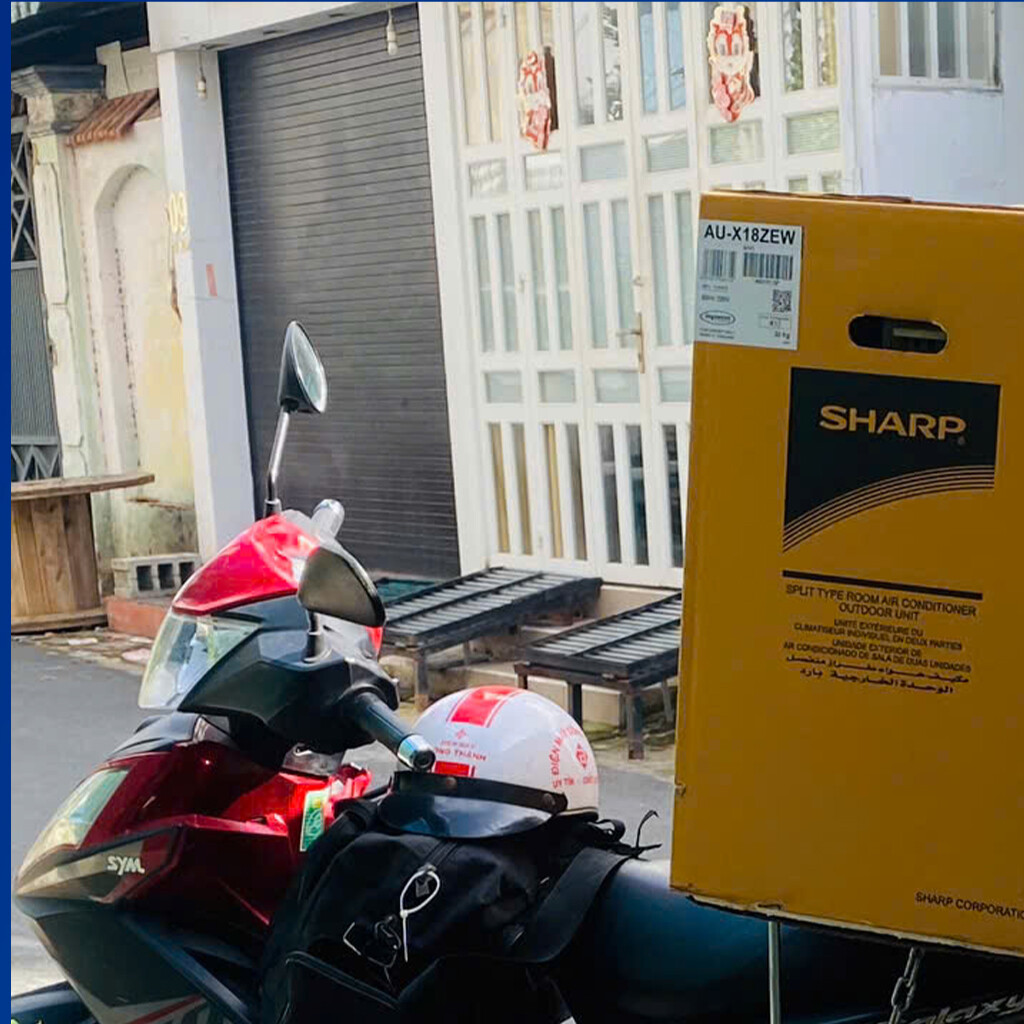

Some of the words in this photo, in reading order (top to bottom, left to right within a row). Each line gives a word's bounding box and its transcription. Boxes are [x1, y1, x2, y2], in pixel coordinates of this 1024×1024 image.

[704, 224, 796, 246] AU-X18ZEW
[818, 404, 967, 440] SHARP
[786, 584, 813, 597] SPLIT
[817, 588, 844, 600] TYPE
[847, 590, 879, 605] ROOM
[882, 595, 899, 607] AIR
[902, 598, 976, 617] CONDITIONER
[839, 602, 893, 617] OUTDOOR
[896, 610, 920, 621] UNIT
[869, 642, 909, 655] EXTERIOR
[905, 638, 928, 647] DEUX
[930, 641, 962, 651] PARTIES
[784, 642, 796, 650] AR
[872, 652, 892, 662] SALA
[907, 658, 928, 667] DUAS
[930, 660, 971, 673] UNIDADES
[107, 855, 146, 876] SYM
[915, 892, 953, 907] SHARP
